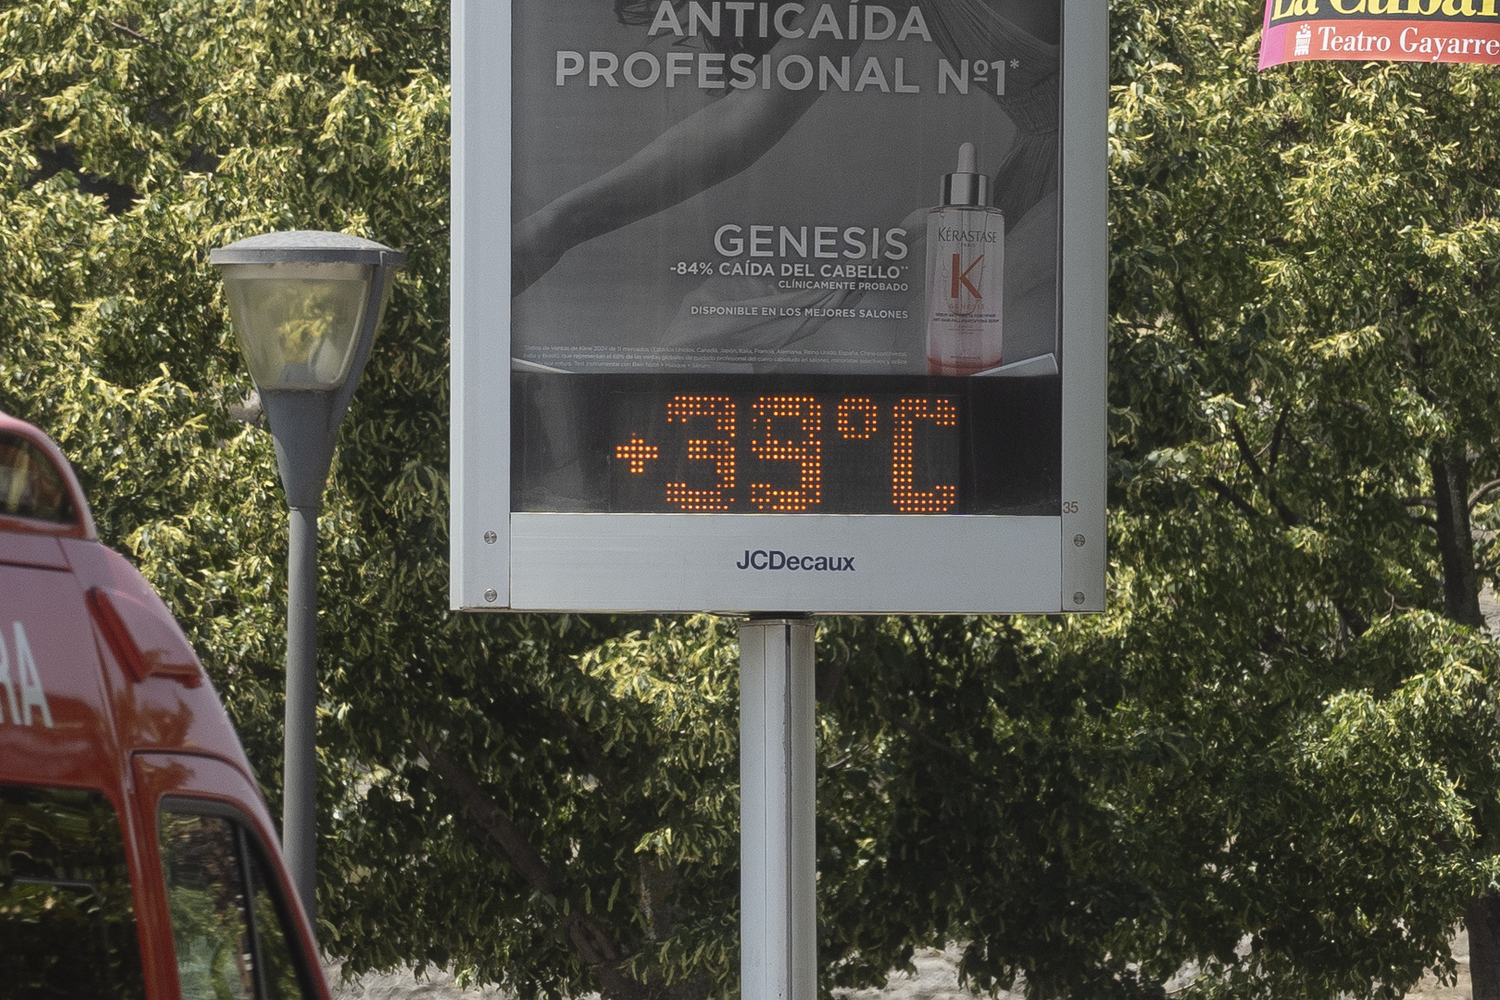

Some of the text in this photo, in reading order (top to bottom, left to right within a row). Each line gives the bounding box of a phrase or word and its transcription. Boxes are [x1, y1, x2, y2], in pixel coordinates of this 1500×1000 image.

[647, 0, 932, 42] ANTICAÍDA
[1318, 26, 1500, 61] Teatro Gayarre
[555, 49, 920, 93] PROFESIONAL
[713, 224, 908, 261] GENESIS
[938, 227, 997, 243] KÉRASTASE
[670, 261, 713, 276] -84%
[718, 260, 775, 276] CAÍDA
[781, 263, 815, 277] DEL
[778, 278, 909, 292] CLÍNICAMENTE PROBADO
[691, 306, 909, 319] DISPONIBLE EN LOS MEJORES SALONES
[1062, 501, 1079, 514] 35
[736, 550, 856, 572] JCDecaux
